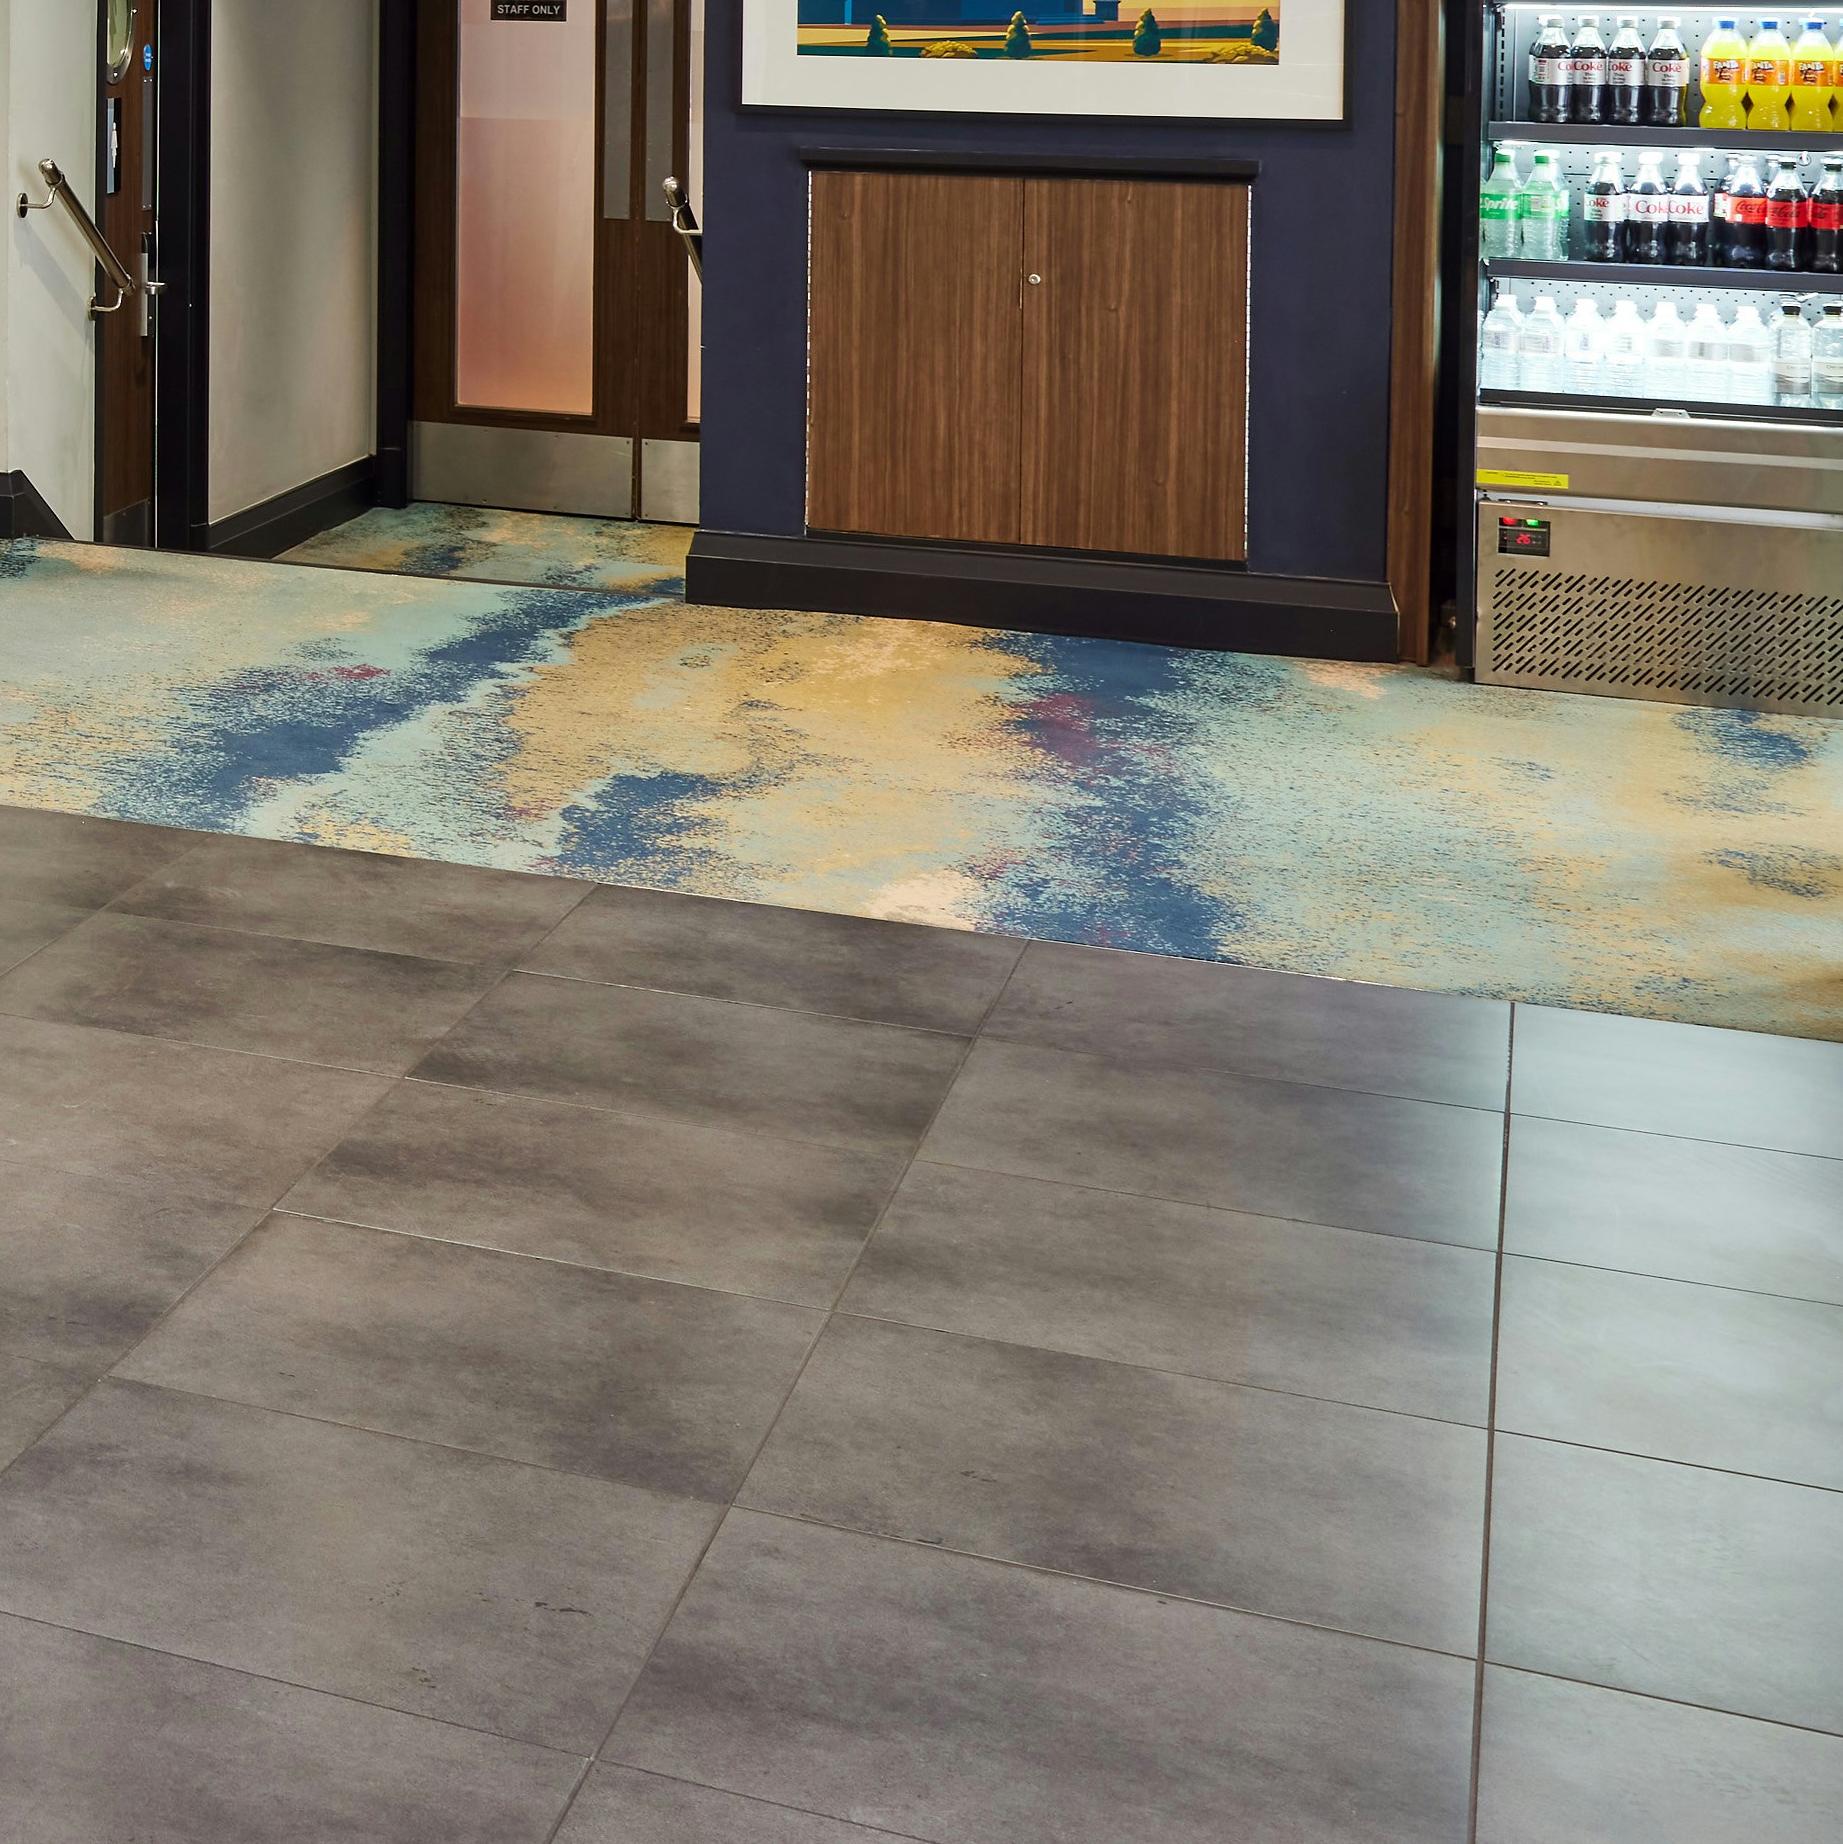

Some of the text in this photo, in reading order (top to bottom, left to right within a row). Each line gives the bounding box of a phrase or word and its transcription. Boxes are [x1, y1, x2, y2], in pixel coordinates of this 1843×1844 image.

[497, 4, 561, 15] STAFF ONLY
[1574, 59, 1603, 71] Coke
[1653, 61, 1682, 73] Coke
[1484, 197, 1519, 211] Sprite
[1635, 199, 1668, 214] Cok
